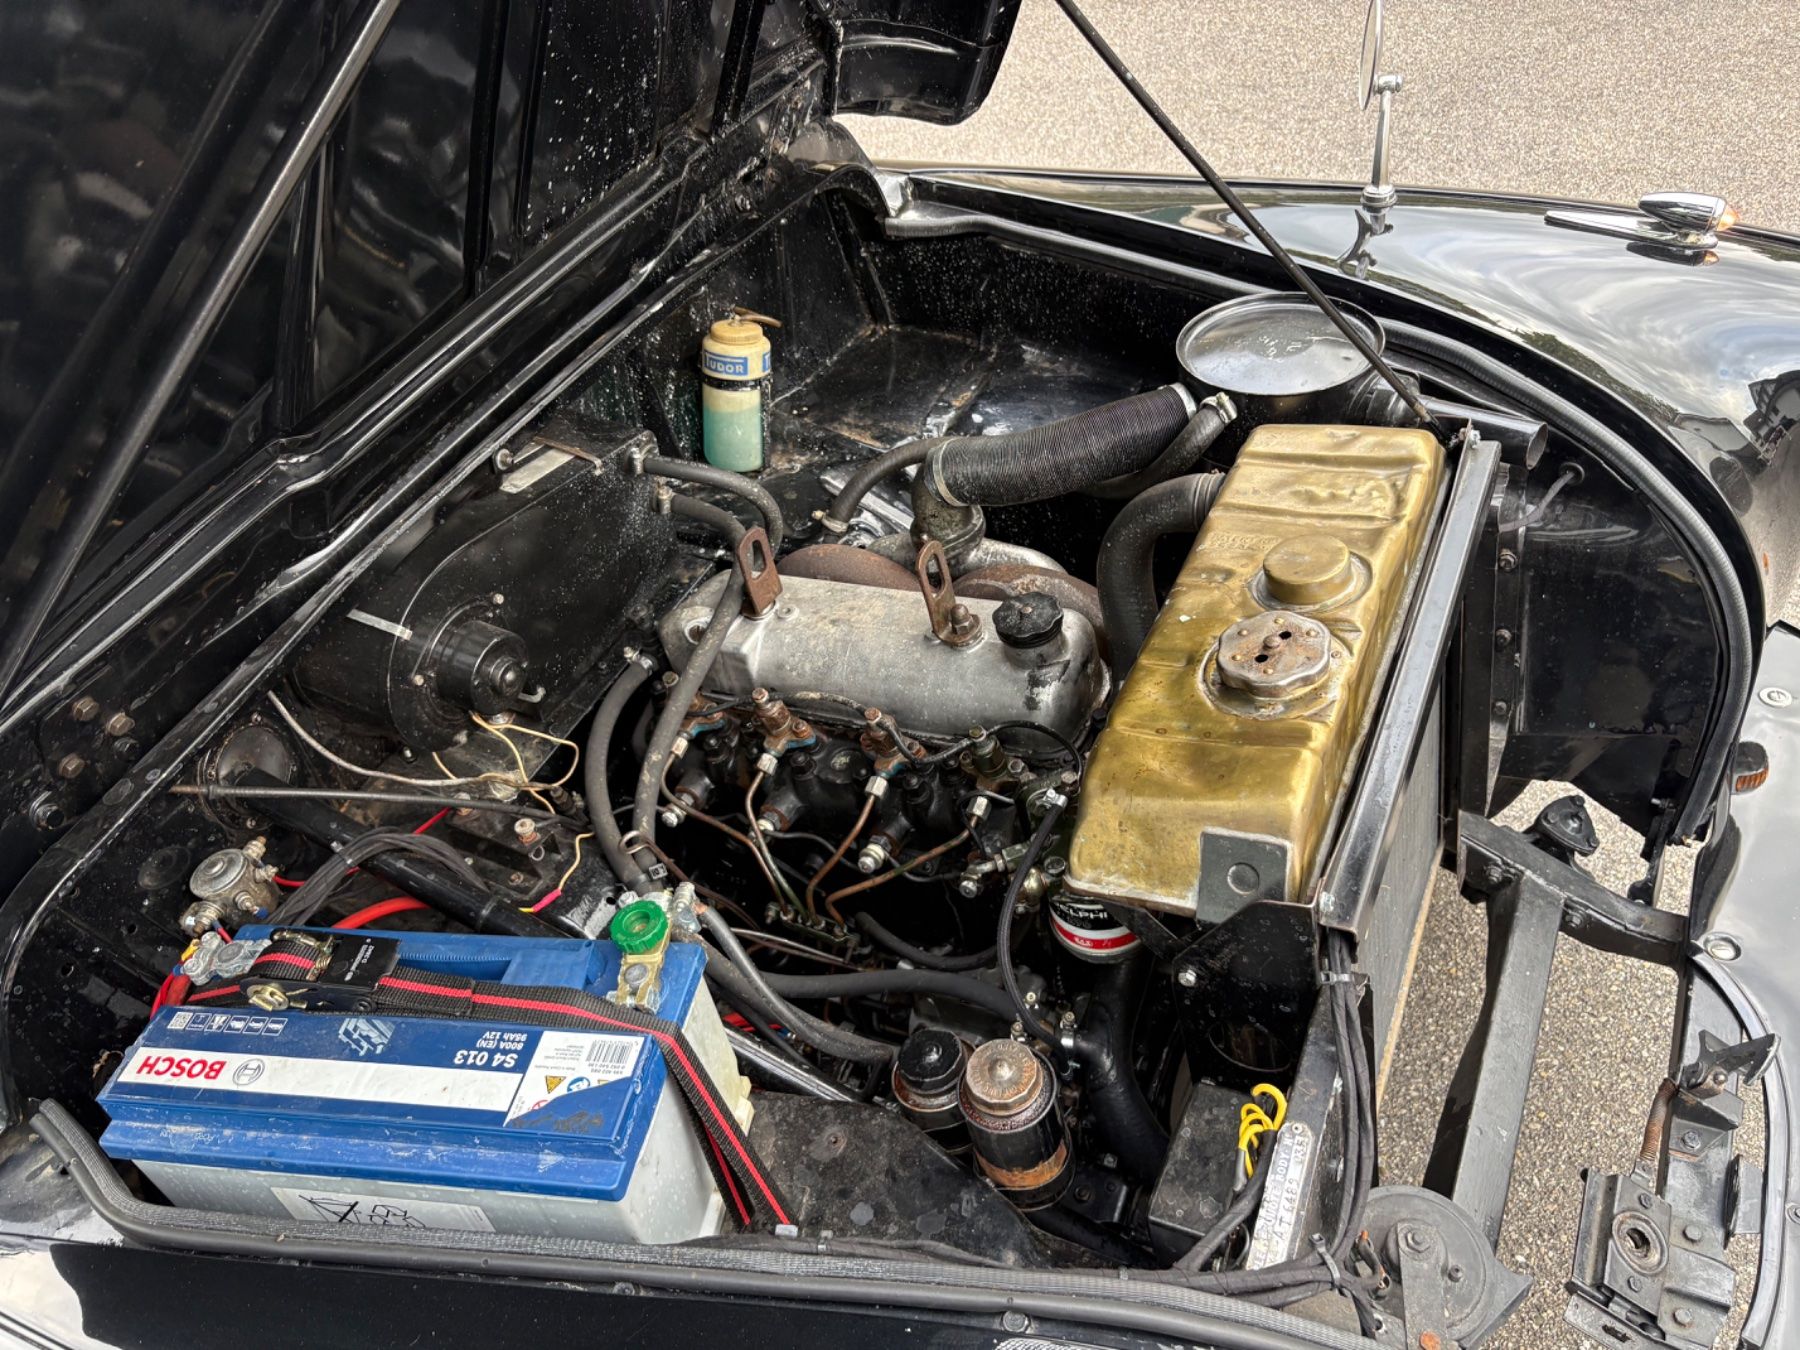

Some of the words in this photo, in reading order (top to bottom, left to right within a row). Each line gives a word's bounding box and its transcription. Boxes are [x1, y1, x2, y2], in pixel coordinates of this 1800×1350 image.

[705, 353, 744, 373] TUDOR
[482, 1031, 502, 1040] 12V
[503, 1032, 527, 1042] 95Ah
[476, 1038, 498, 1049] (EN)
[499, 1040, 524, 1051] 800A
[454, 1049, 489, 1066] 013
[491, 1052, 518, 1068] S4
[136, 1055, 227, 1080] BOSCH
